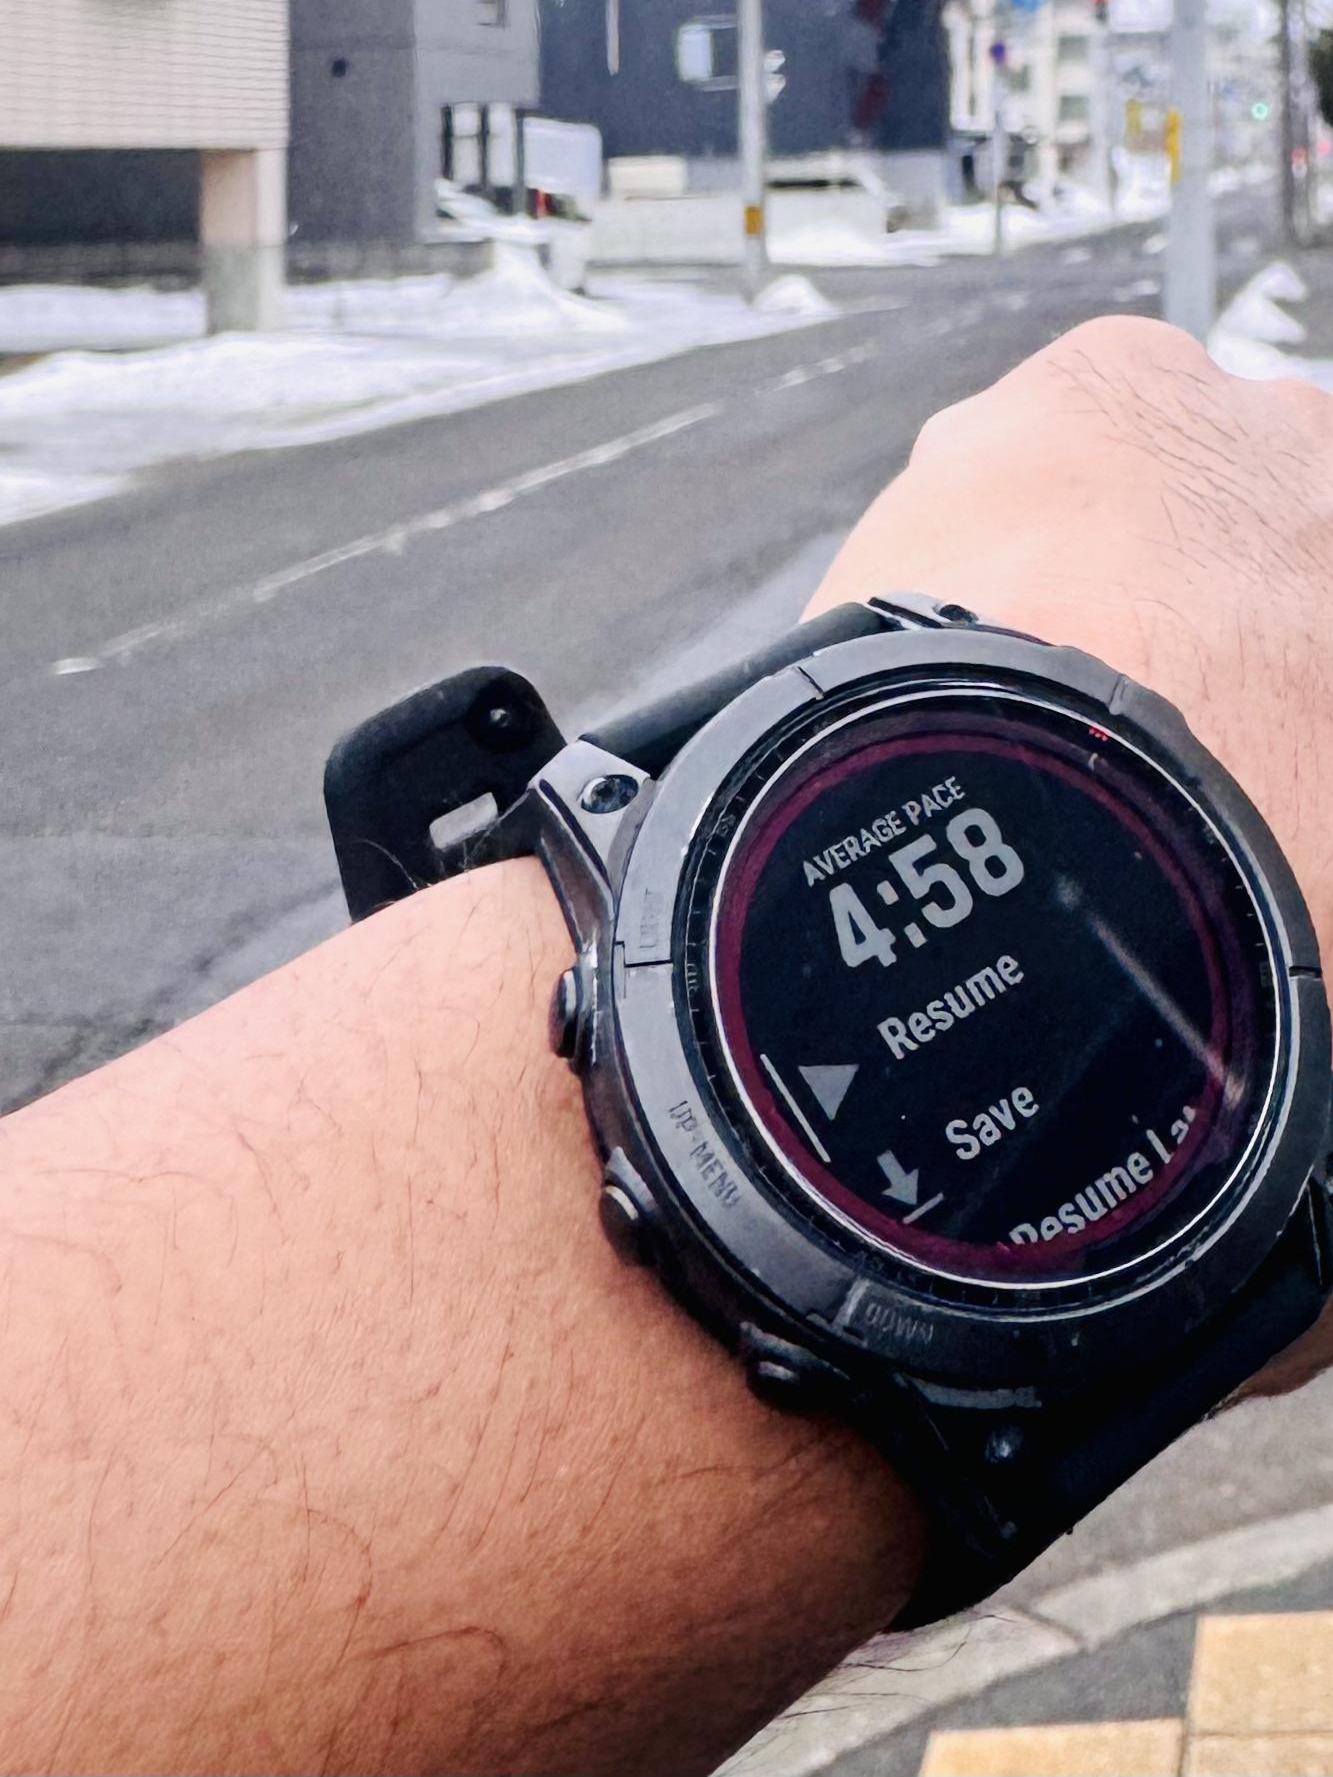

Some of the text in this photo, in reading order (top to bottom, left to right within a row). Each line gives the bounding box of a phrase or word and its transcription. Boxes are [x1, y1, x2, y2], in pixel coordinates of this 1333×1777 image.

[803, 775, 966, 887] AVERAGE PACE
[829, 807, 1025, 968] 4:58
[876, 955, 1025, 1060] Resume
[945, 1086, 1040, 1160] Save
